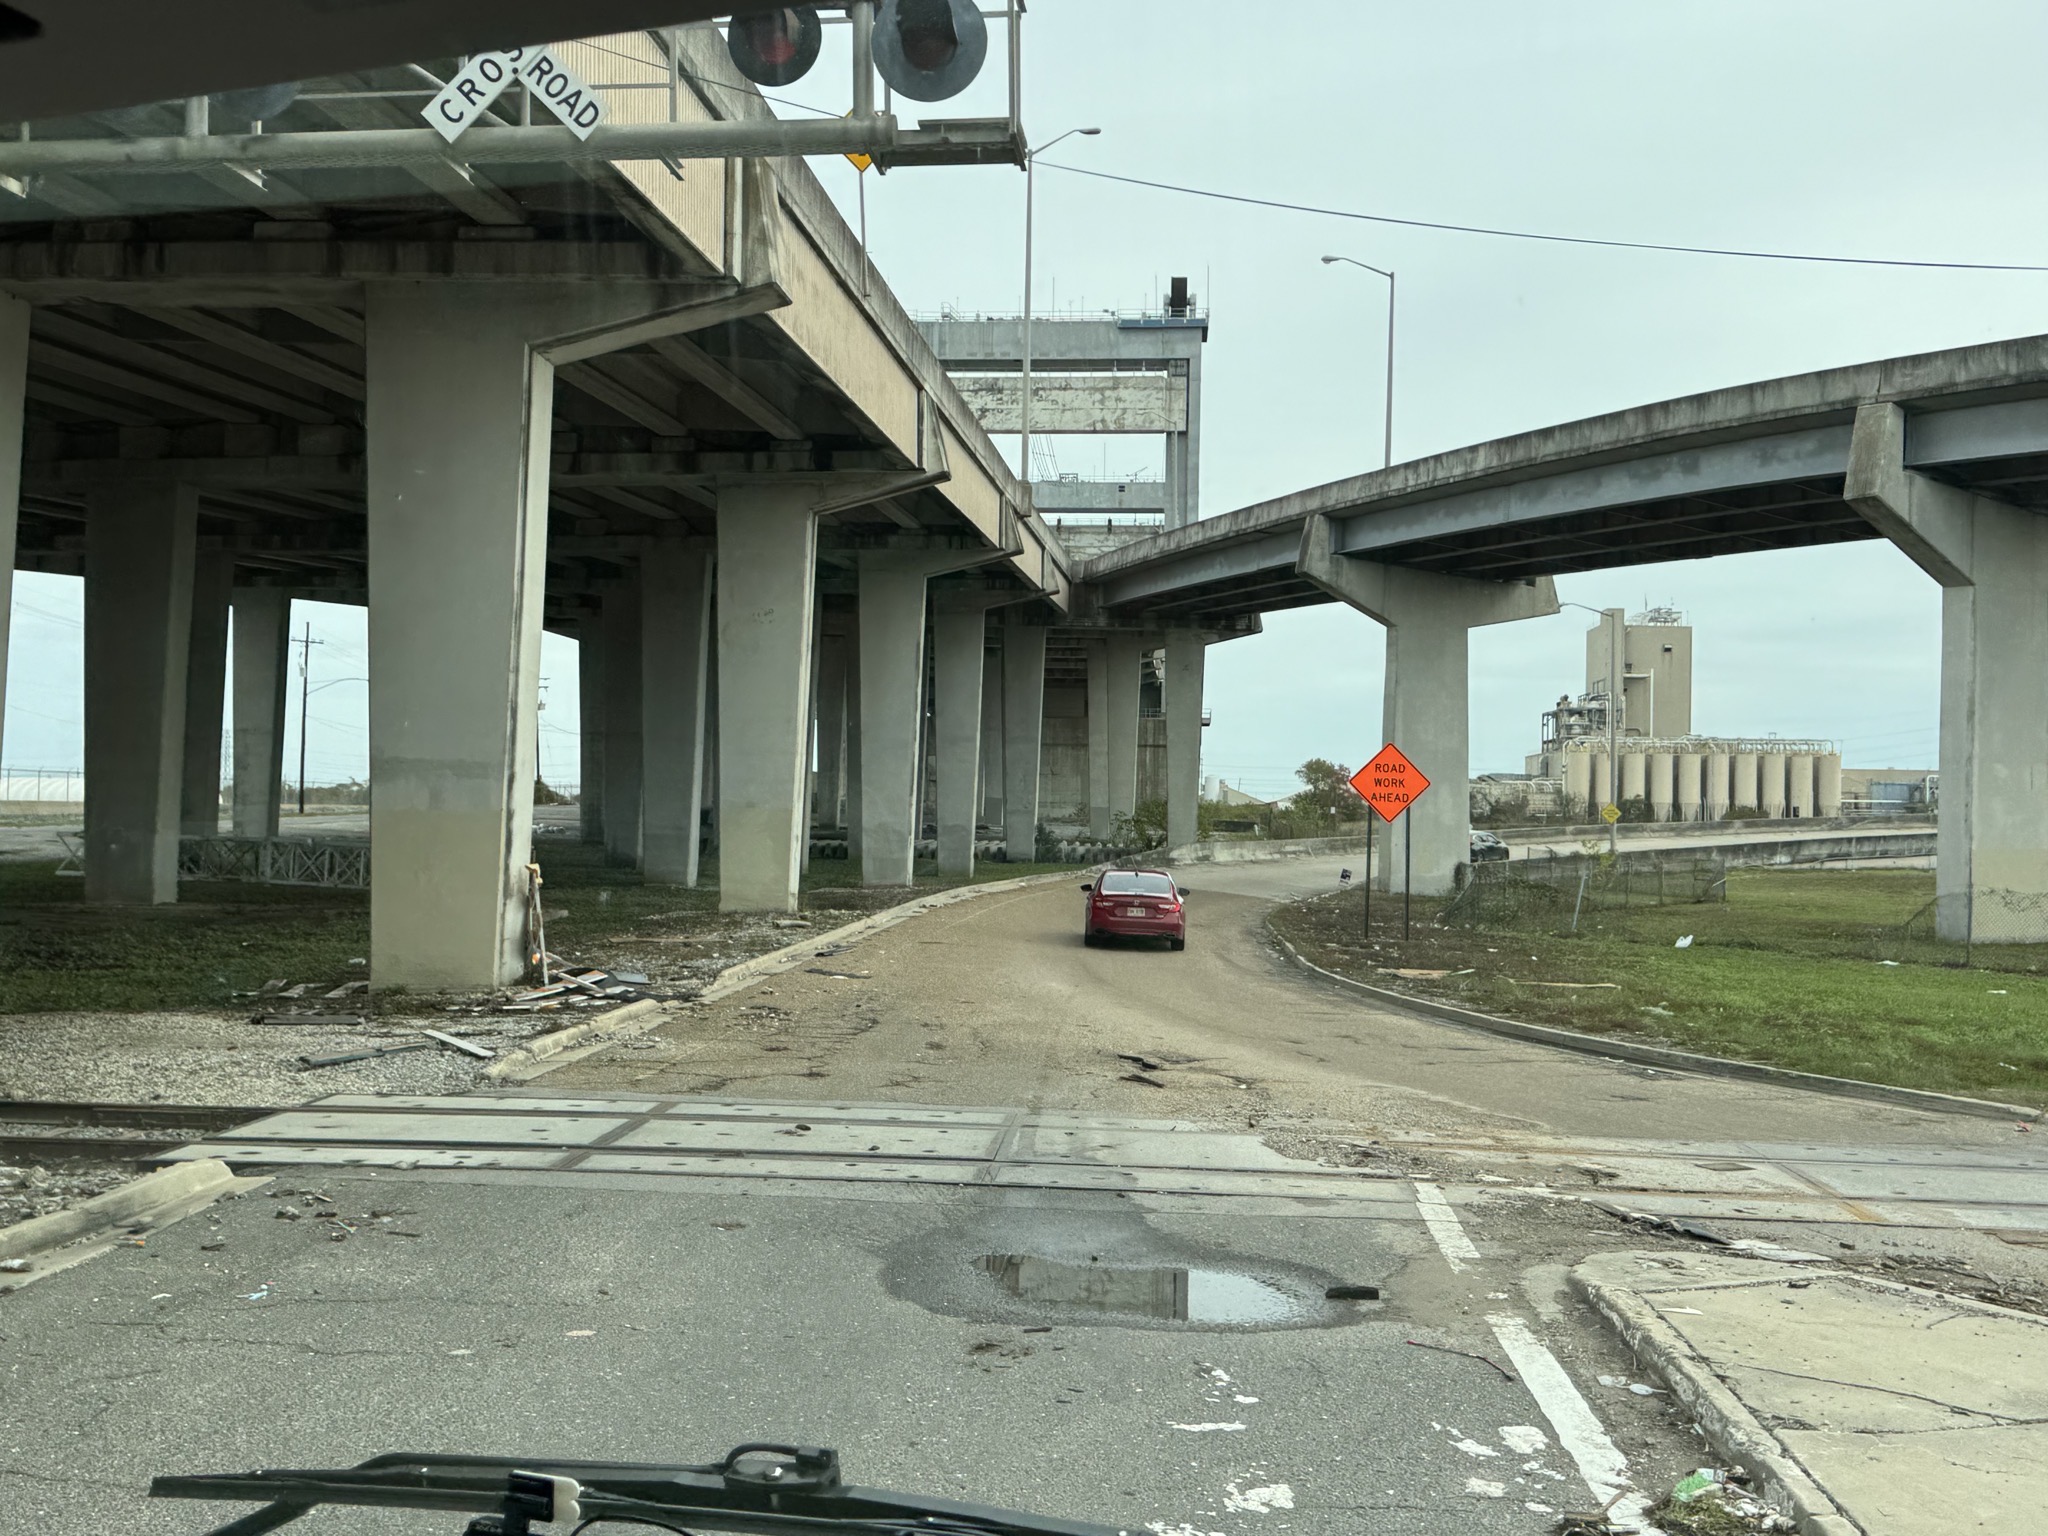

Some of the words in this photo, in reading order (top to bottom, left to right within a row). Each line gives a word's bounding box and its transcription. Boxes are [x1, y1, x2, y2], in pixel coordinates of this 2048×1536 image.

[527, 55, 599, 128] ROAD
[1374, 763, 1406, 773] ROAD
[1373, 777, 1405, 788] WORK
[1370, 792, 1409, 803] AHEAD
